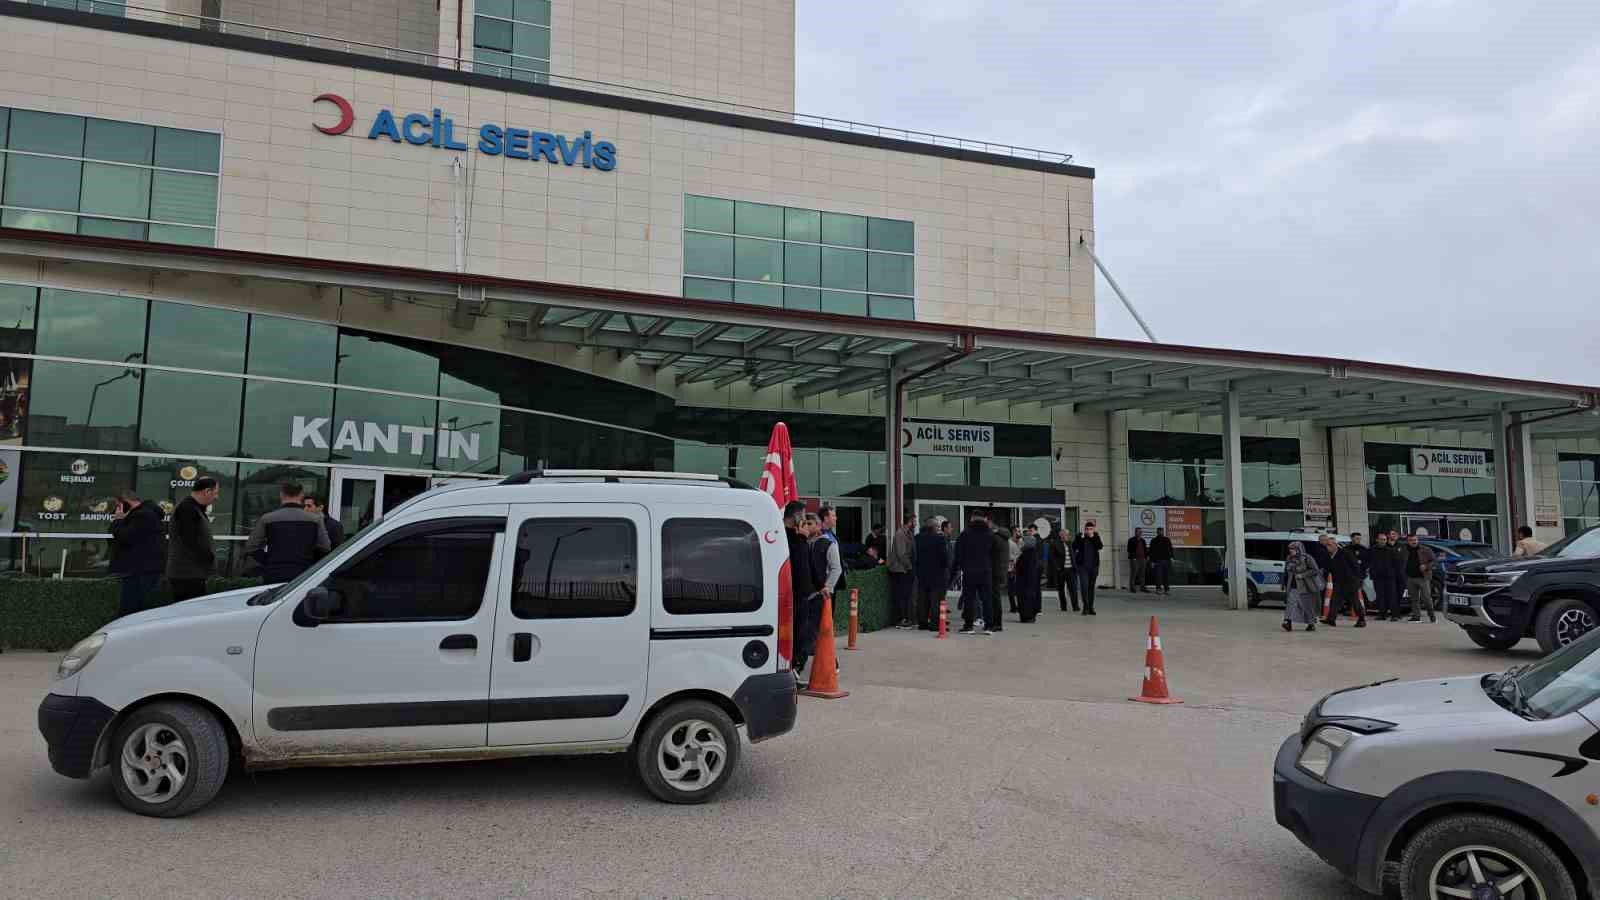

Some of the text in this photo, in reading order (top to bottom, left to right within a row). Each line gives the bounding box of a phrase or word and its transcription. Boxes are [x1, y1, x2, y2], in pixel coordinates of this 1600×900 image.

[367, 105, 618, 172] ACİL SERVİS
[291, 415, 480, 461] KANTİN
[917, 425, 990, 441] ACİL SERVİS
[1431, 451, 1483, 464] ACİL SERVİS
[38, 512, 67, 520] TOST
